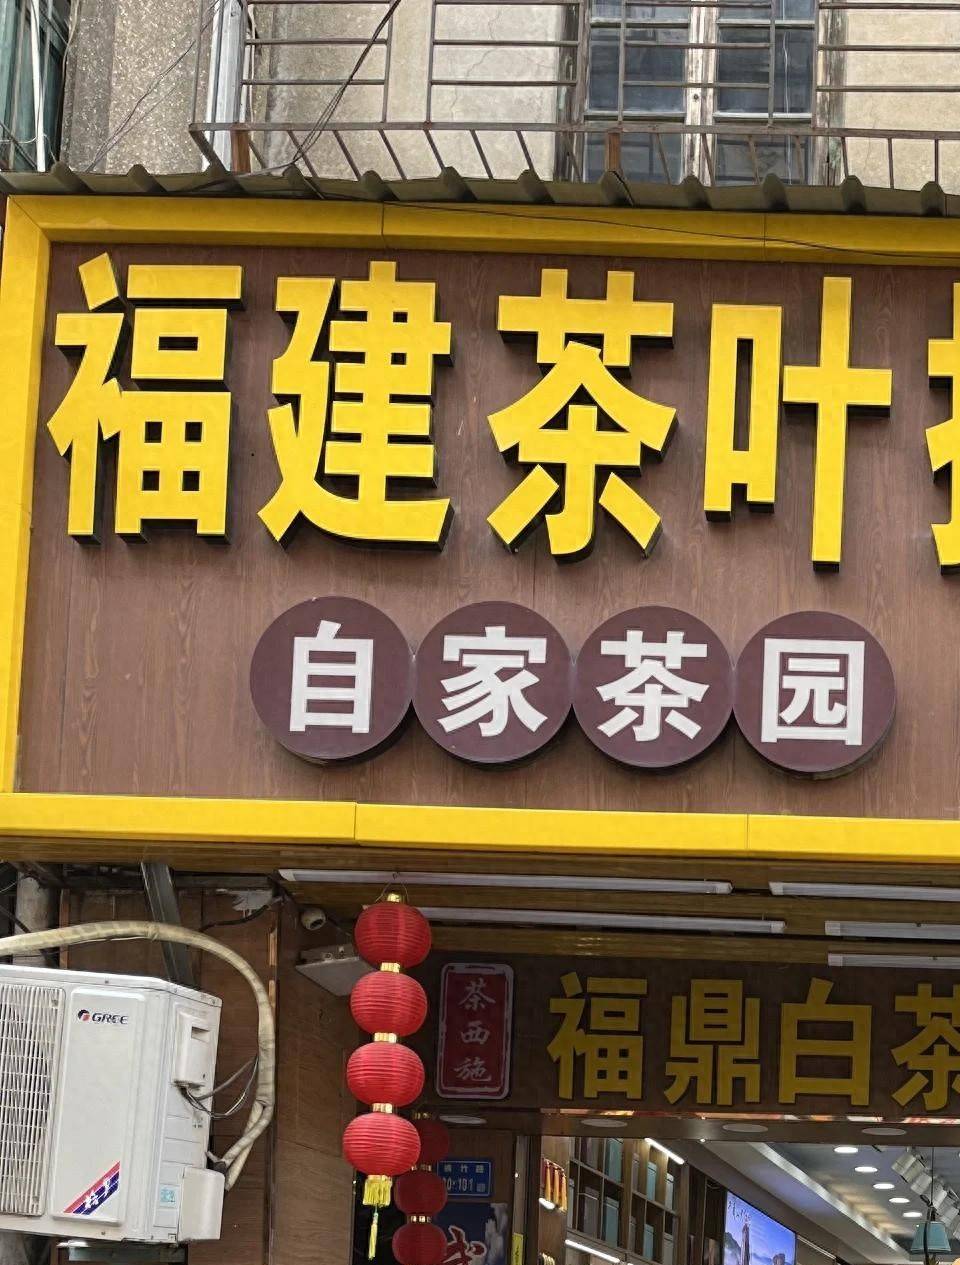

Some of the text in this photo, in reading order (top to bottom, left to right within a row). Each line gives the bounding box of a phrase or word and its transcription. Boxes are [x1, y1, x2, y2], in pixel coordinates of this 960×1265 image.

[289, 620, 867, 747] 自家茶园
[92, 1012, 129, 1025] GREE
[453, 977, 496, 1084] 茶西施
